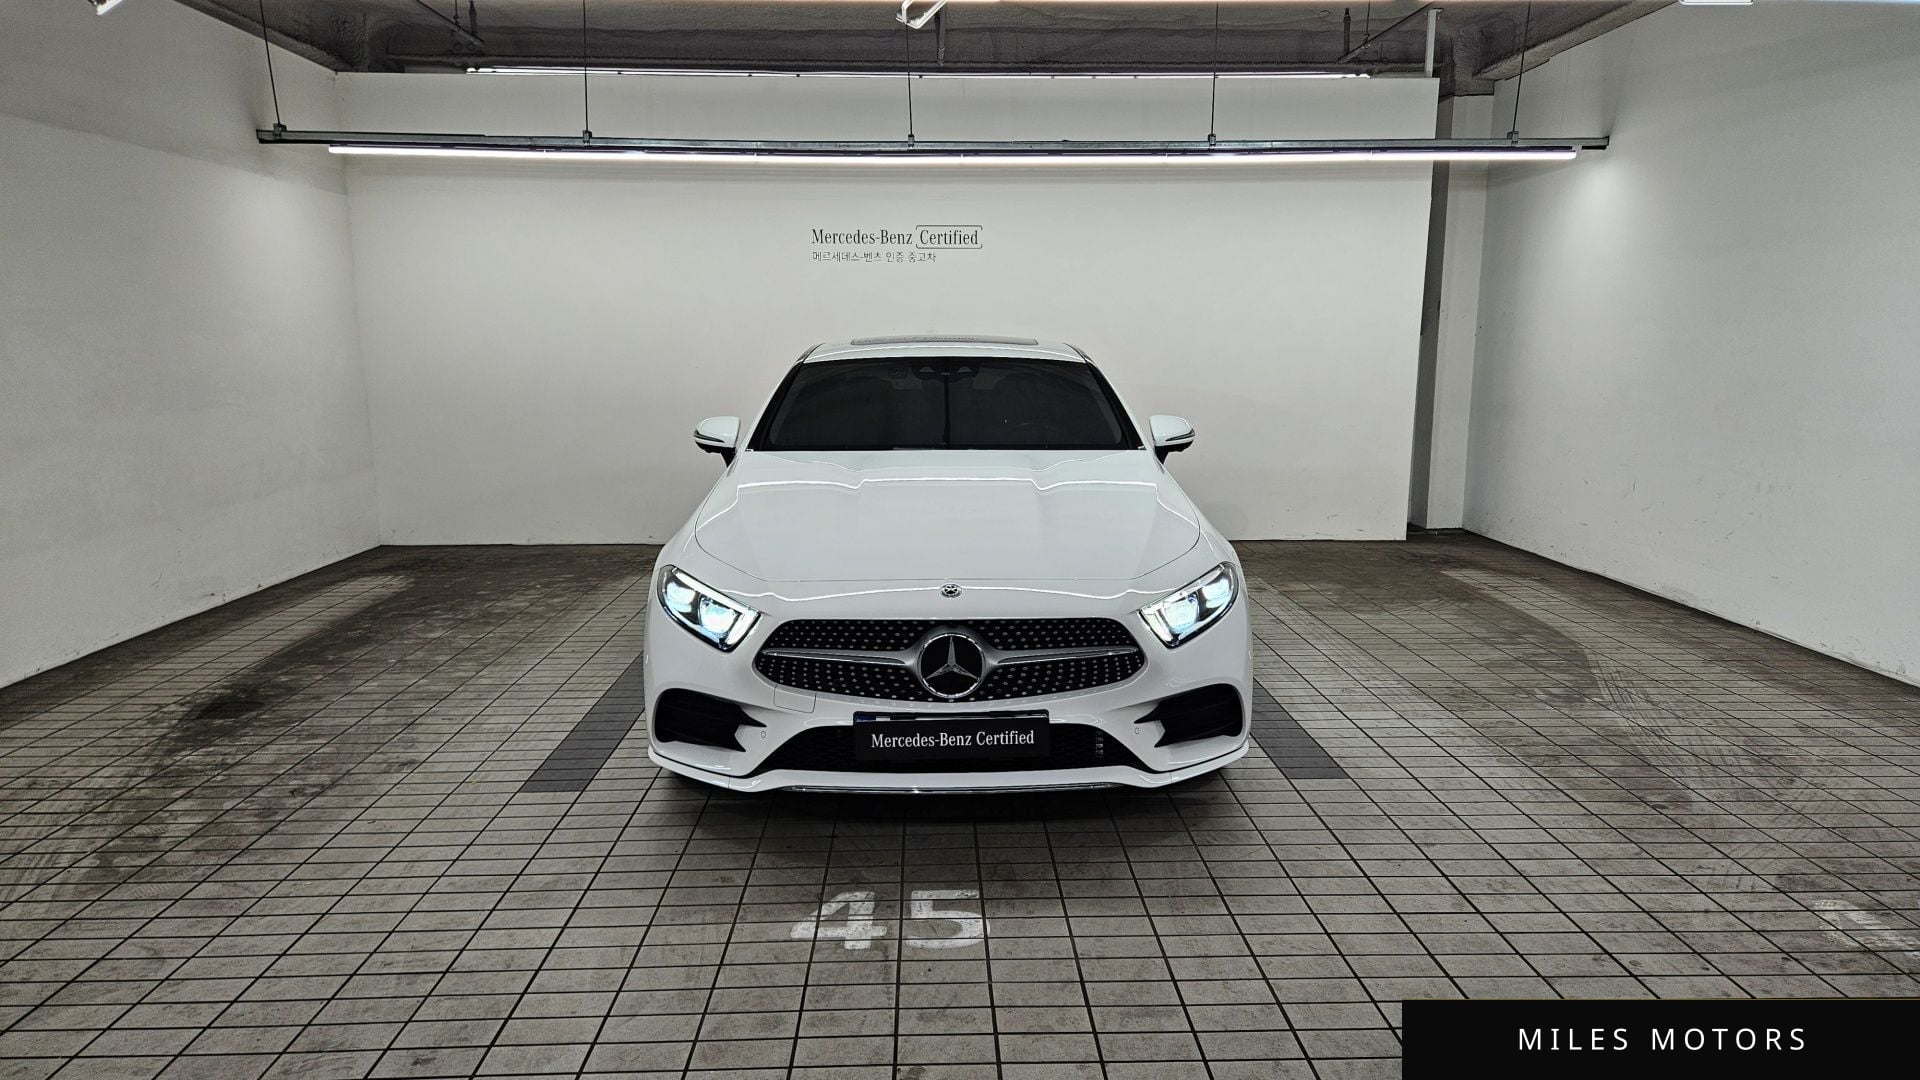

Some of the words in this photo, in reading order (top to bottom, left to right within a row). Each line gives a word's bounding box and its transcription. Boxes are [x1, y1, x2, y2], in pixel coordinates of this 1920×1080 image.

[811, 228, 913, 245] Mercedes-Benz
[919, 229, 979, 245] Certified
[812, 251, 882, 263] 메르세데스-벤츠
[885, 251, 904, 263] 인증
[908, 251, 936, 263] 중고차
[871, 733, 972, 748] Mercedes-Benz
[976, 730, 1035, 745] Certified
[790, 889, 990, 950] 45
